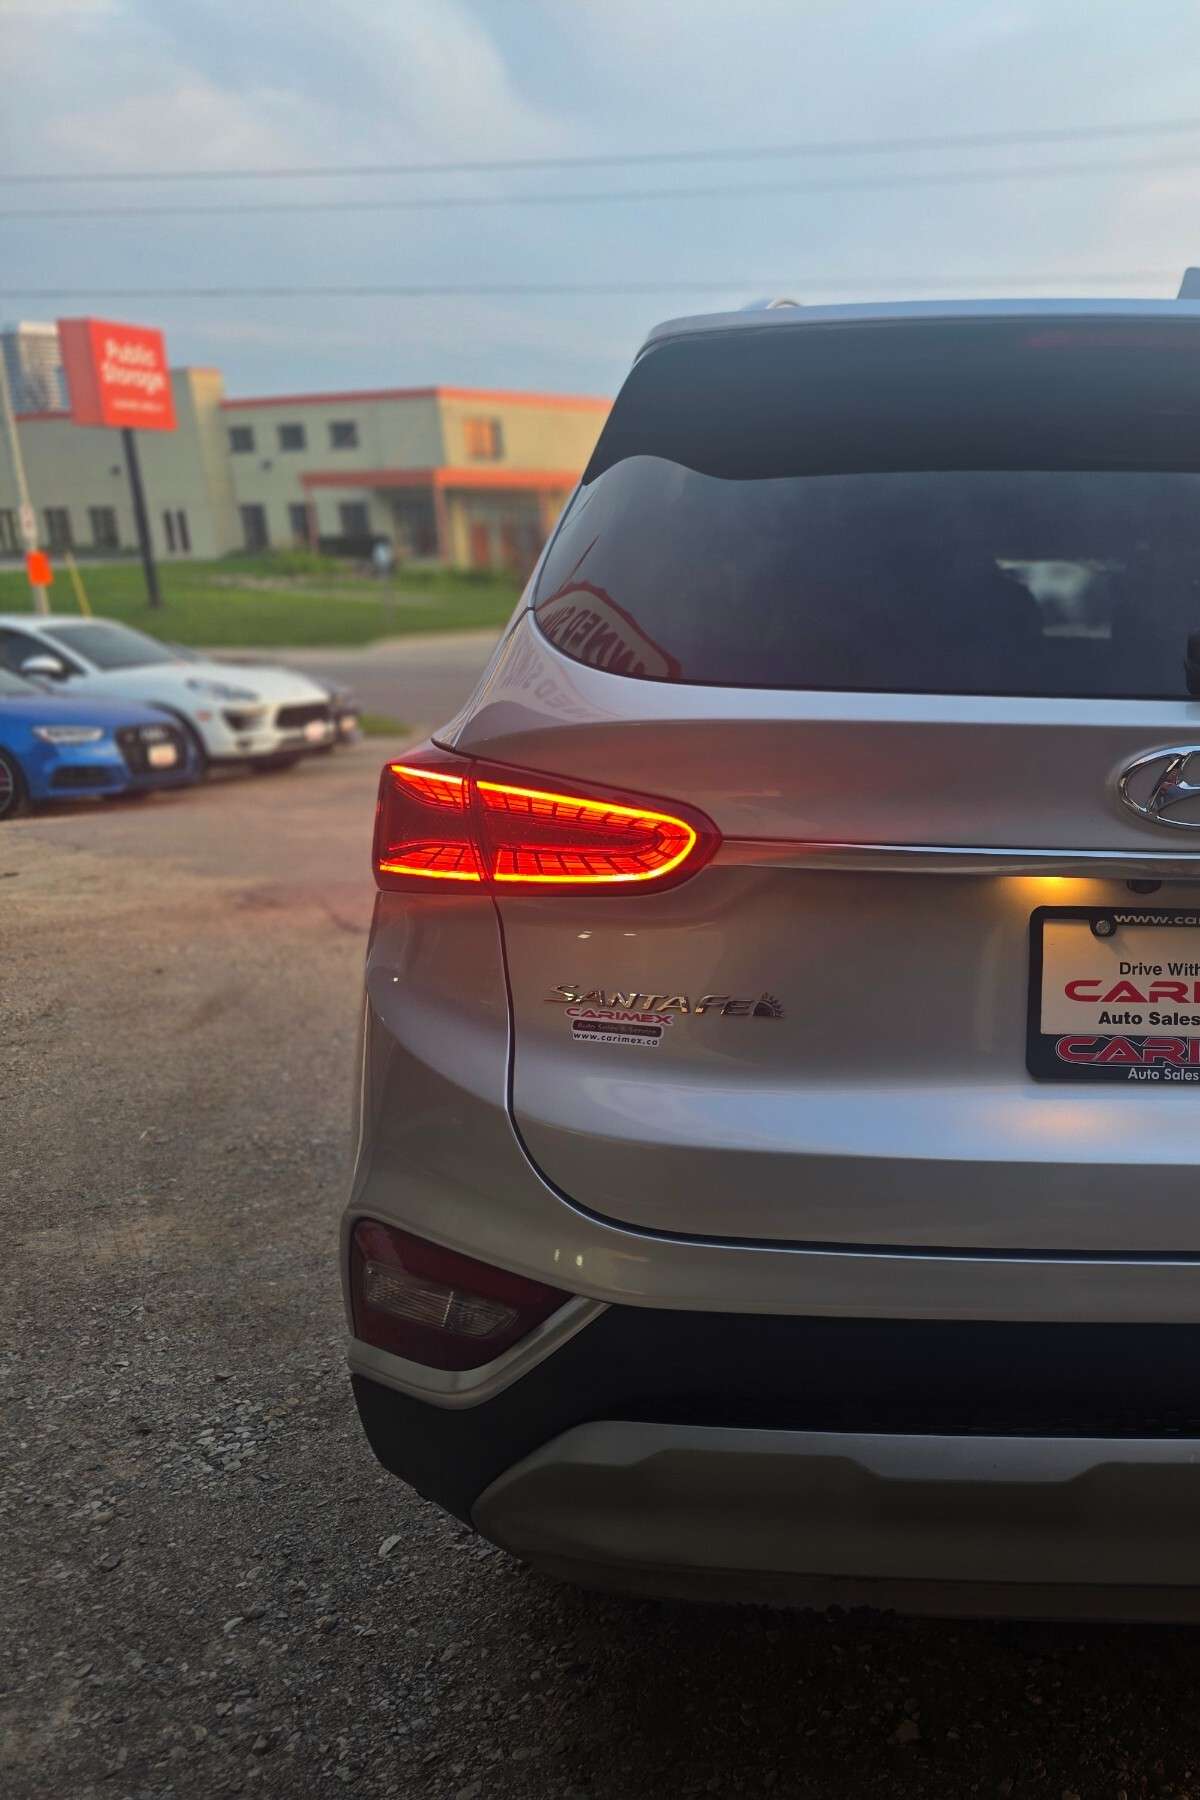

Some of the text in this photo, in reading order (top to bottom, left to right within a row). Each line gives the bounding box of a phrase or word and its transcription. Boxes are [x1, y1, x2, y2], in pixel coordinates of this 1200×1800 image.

[1119, 962, 1162, 976] Drive
[566, 1008, 672, 1024] CARIMEX
[1099, 1011, 1143, 1026] Auto
[1149, 1012, 1200, 1027] Sales
[1128, 1068, 1160, 1080] Auto
[1164, 1069, 1199, 1081] Sales
